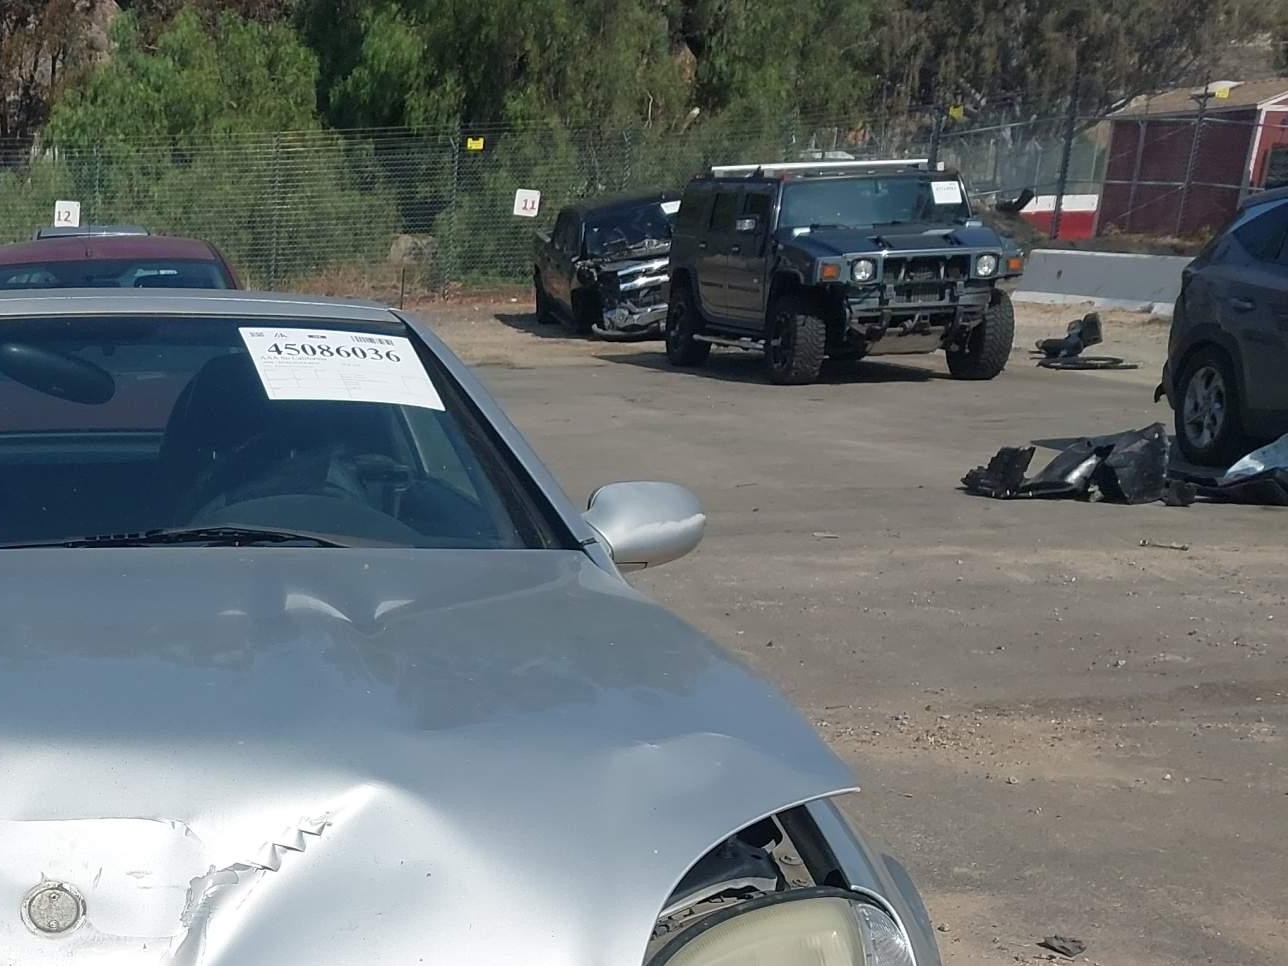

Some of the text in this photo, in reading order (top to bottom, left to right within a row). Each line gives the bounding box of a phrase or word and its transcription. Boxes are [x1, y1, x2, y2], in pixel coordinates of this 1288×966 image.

[522, 198, 537, 211] 11
[56, 210, 71, 222] 12
[267, 342, 401, 363] 45086036
